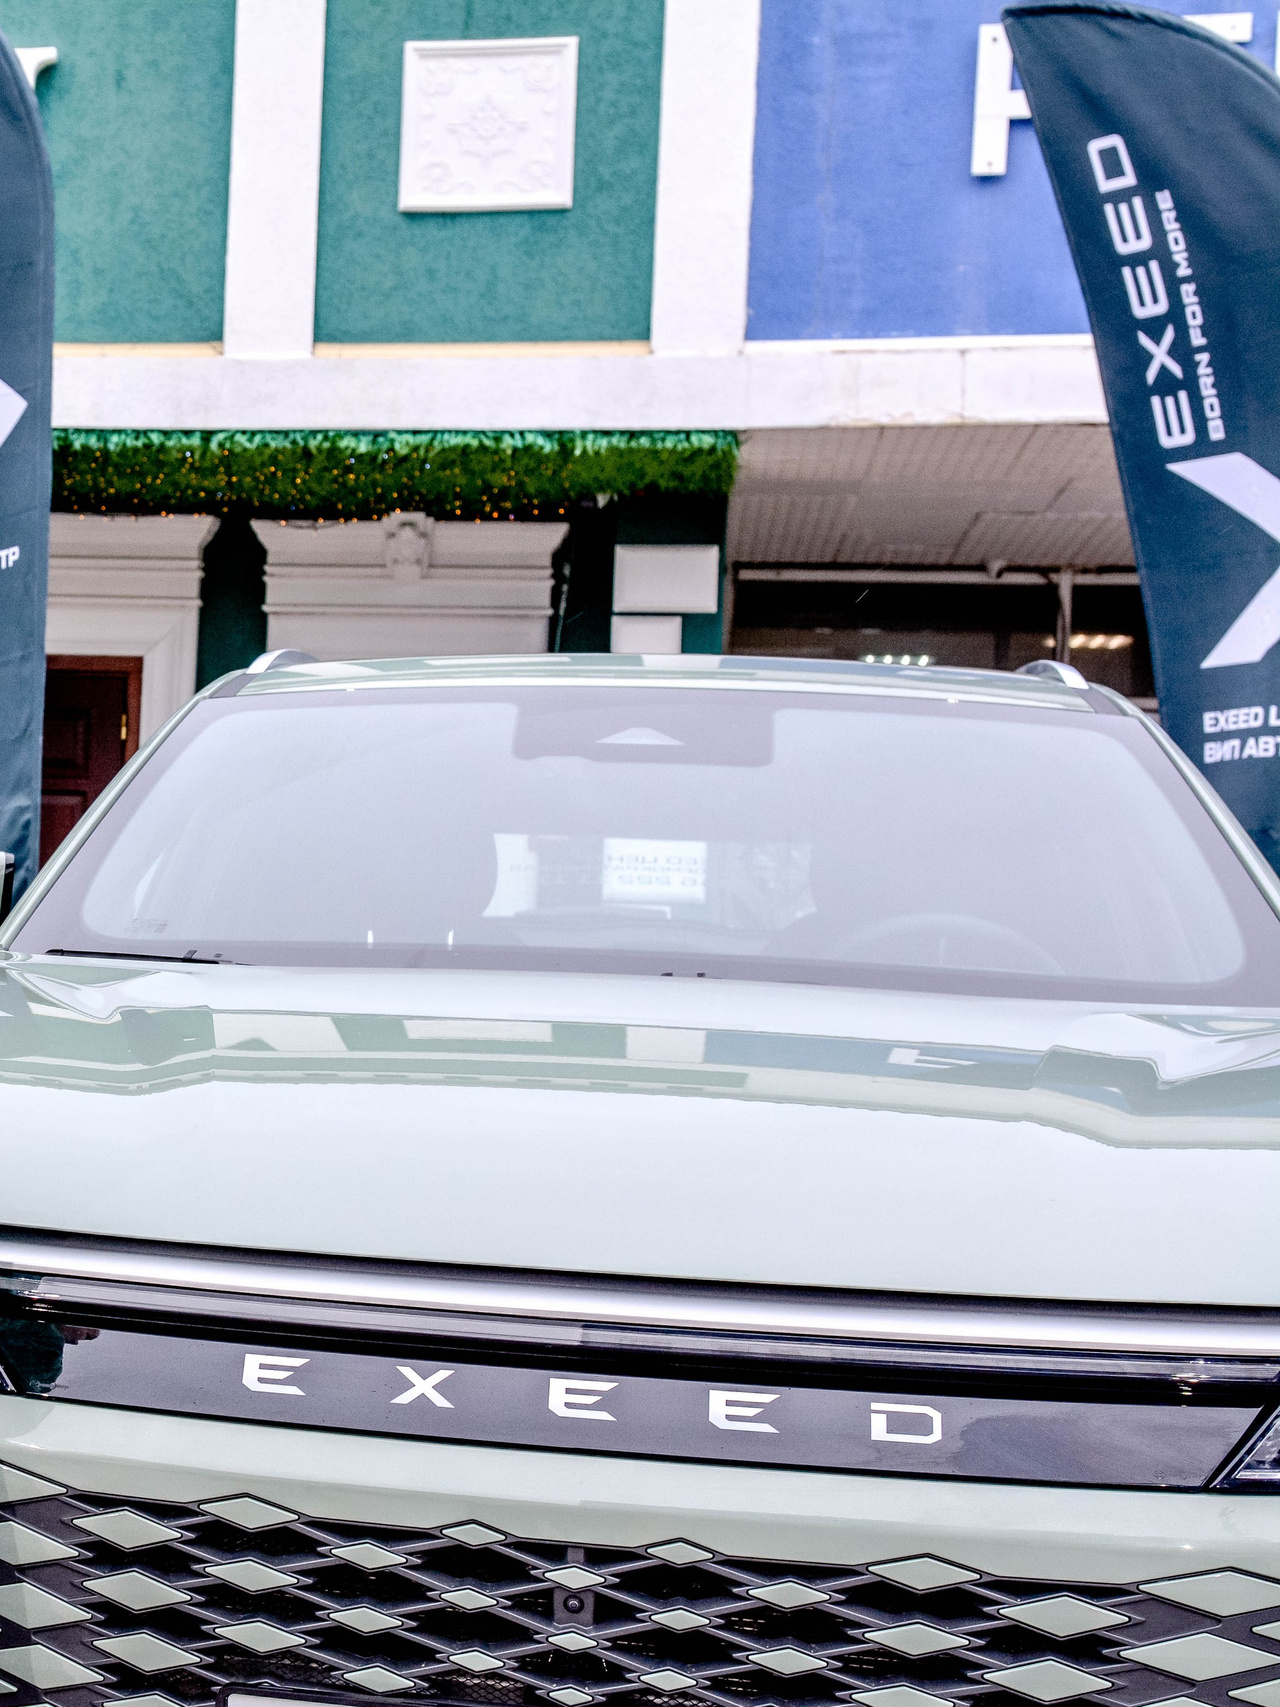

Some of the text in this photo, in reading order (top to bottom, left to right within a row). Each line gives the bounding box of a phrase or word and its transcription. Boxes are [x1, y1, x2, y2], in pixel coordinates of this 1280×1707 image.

[1086, 133, 1196, 449] EXEED
[1155, 189, 1226, 441] BORN FOR MORE
[1203, 705, 1265, 733] EXEED
[1203, 738, 1241, 764] ВИП
[242, 1353, 942, 1445] EXEED
